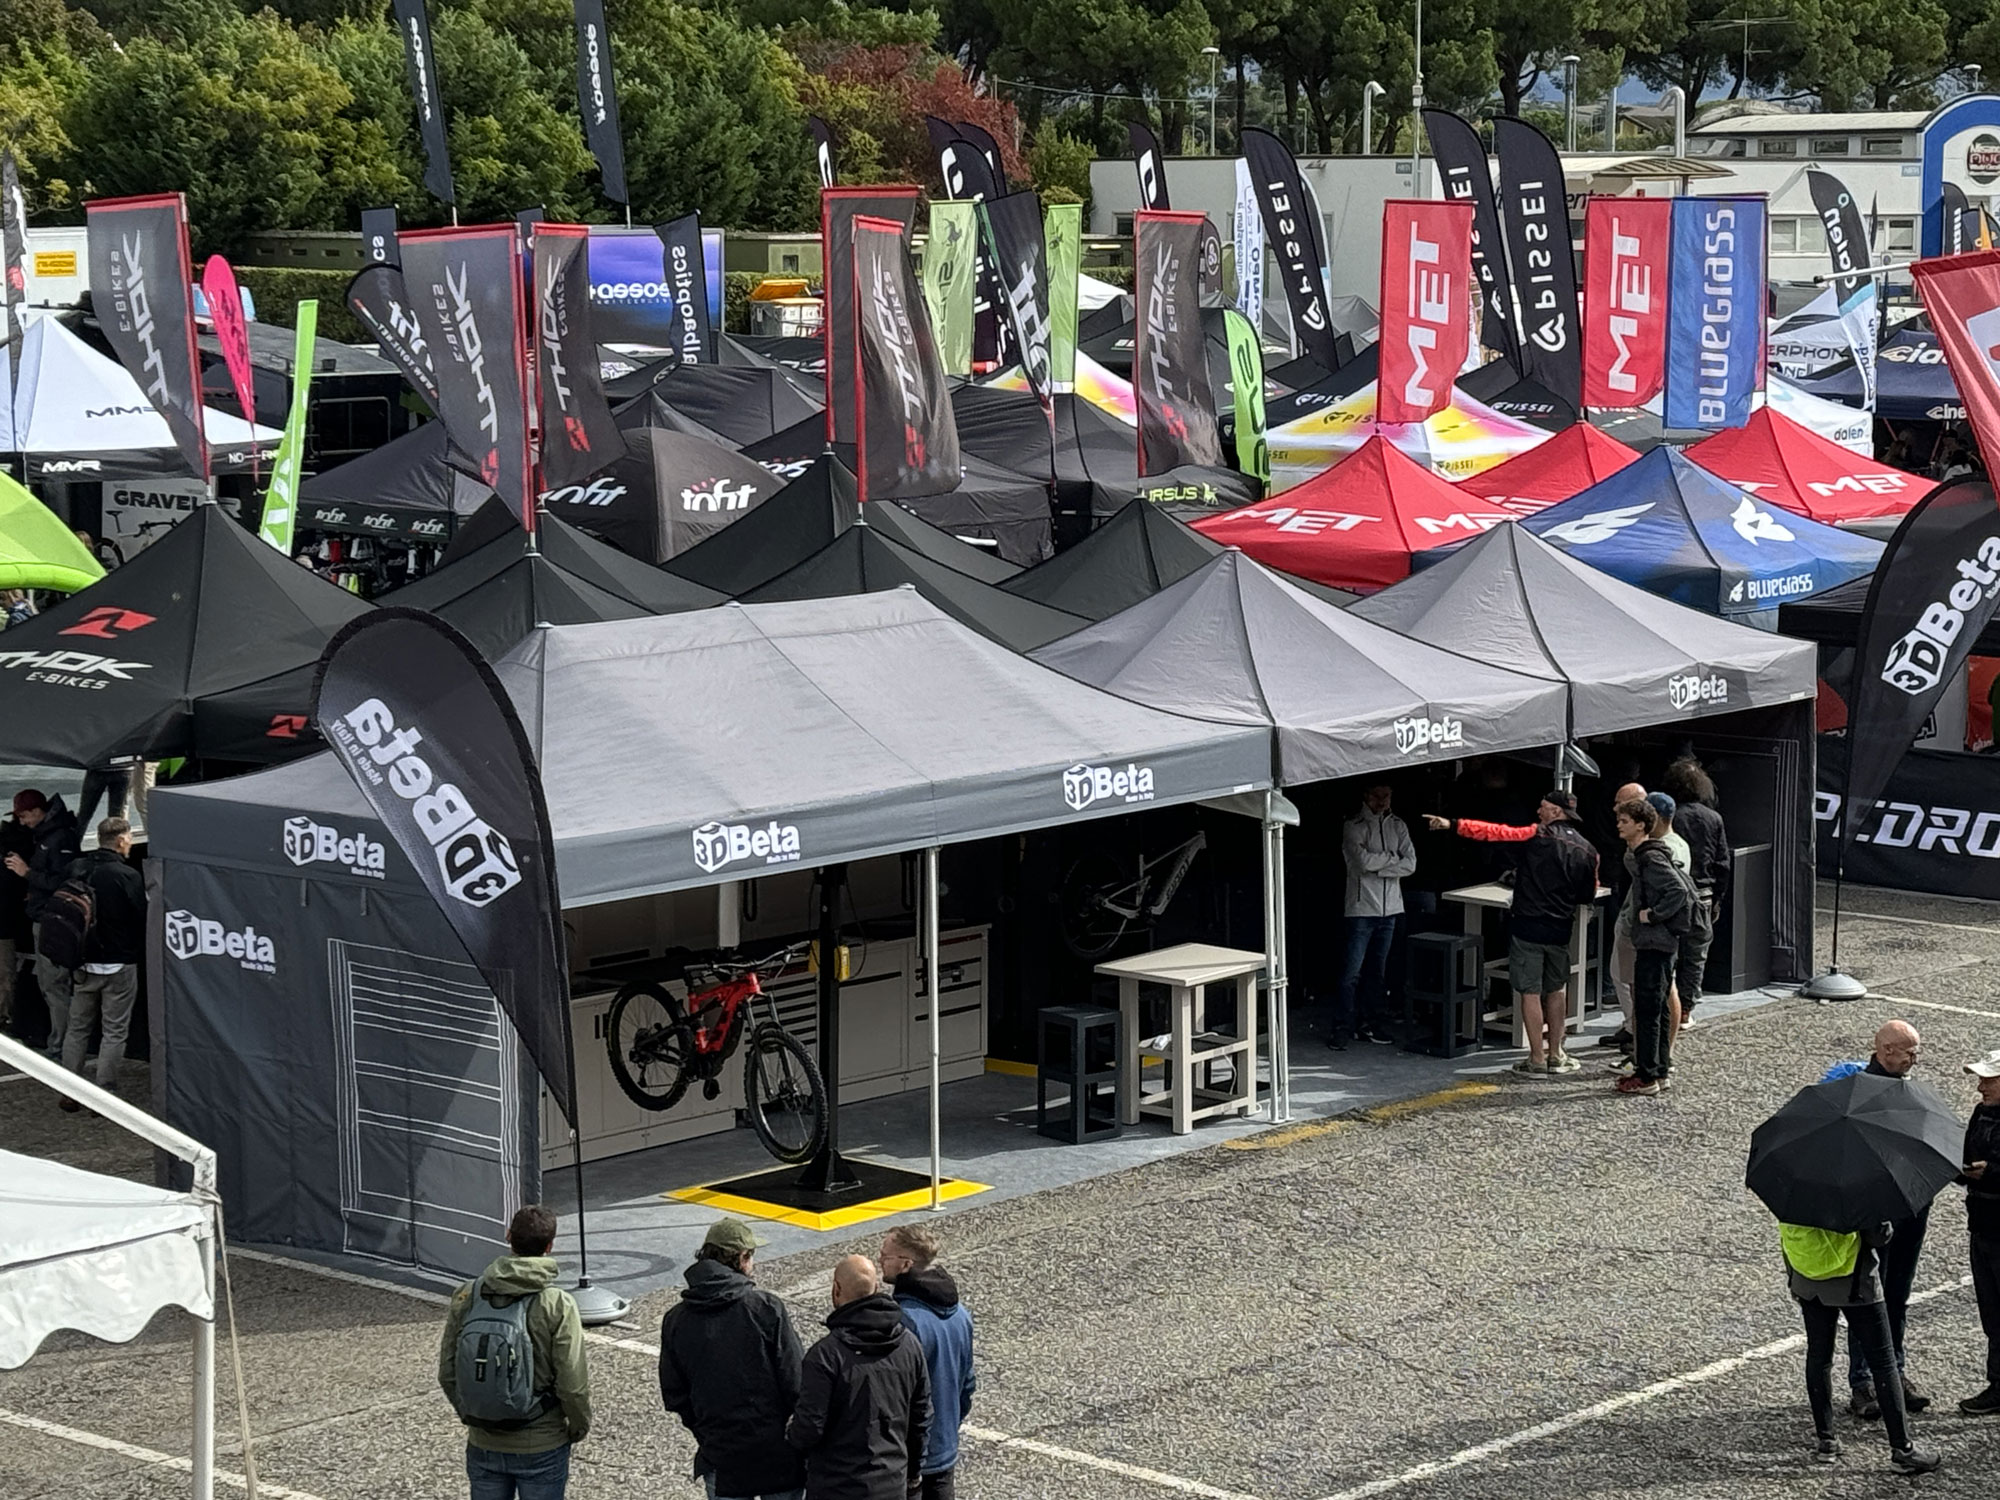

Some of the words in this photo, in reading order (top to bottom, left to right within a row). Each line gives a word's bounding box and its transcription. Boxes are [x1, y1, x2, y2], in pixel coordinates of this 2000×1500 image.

[1405, 220, 1451, 409] MET
[1608, 217, 1651, 393] MET
[1223, 507, 1382, 535] MET
[1807, 473, 1909, 497] MET
